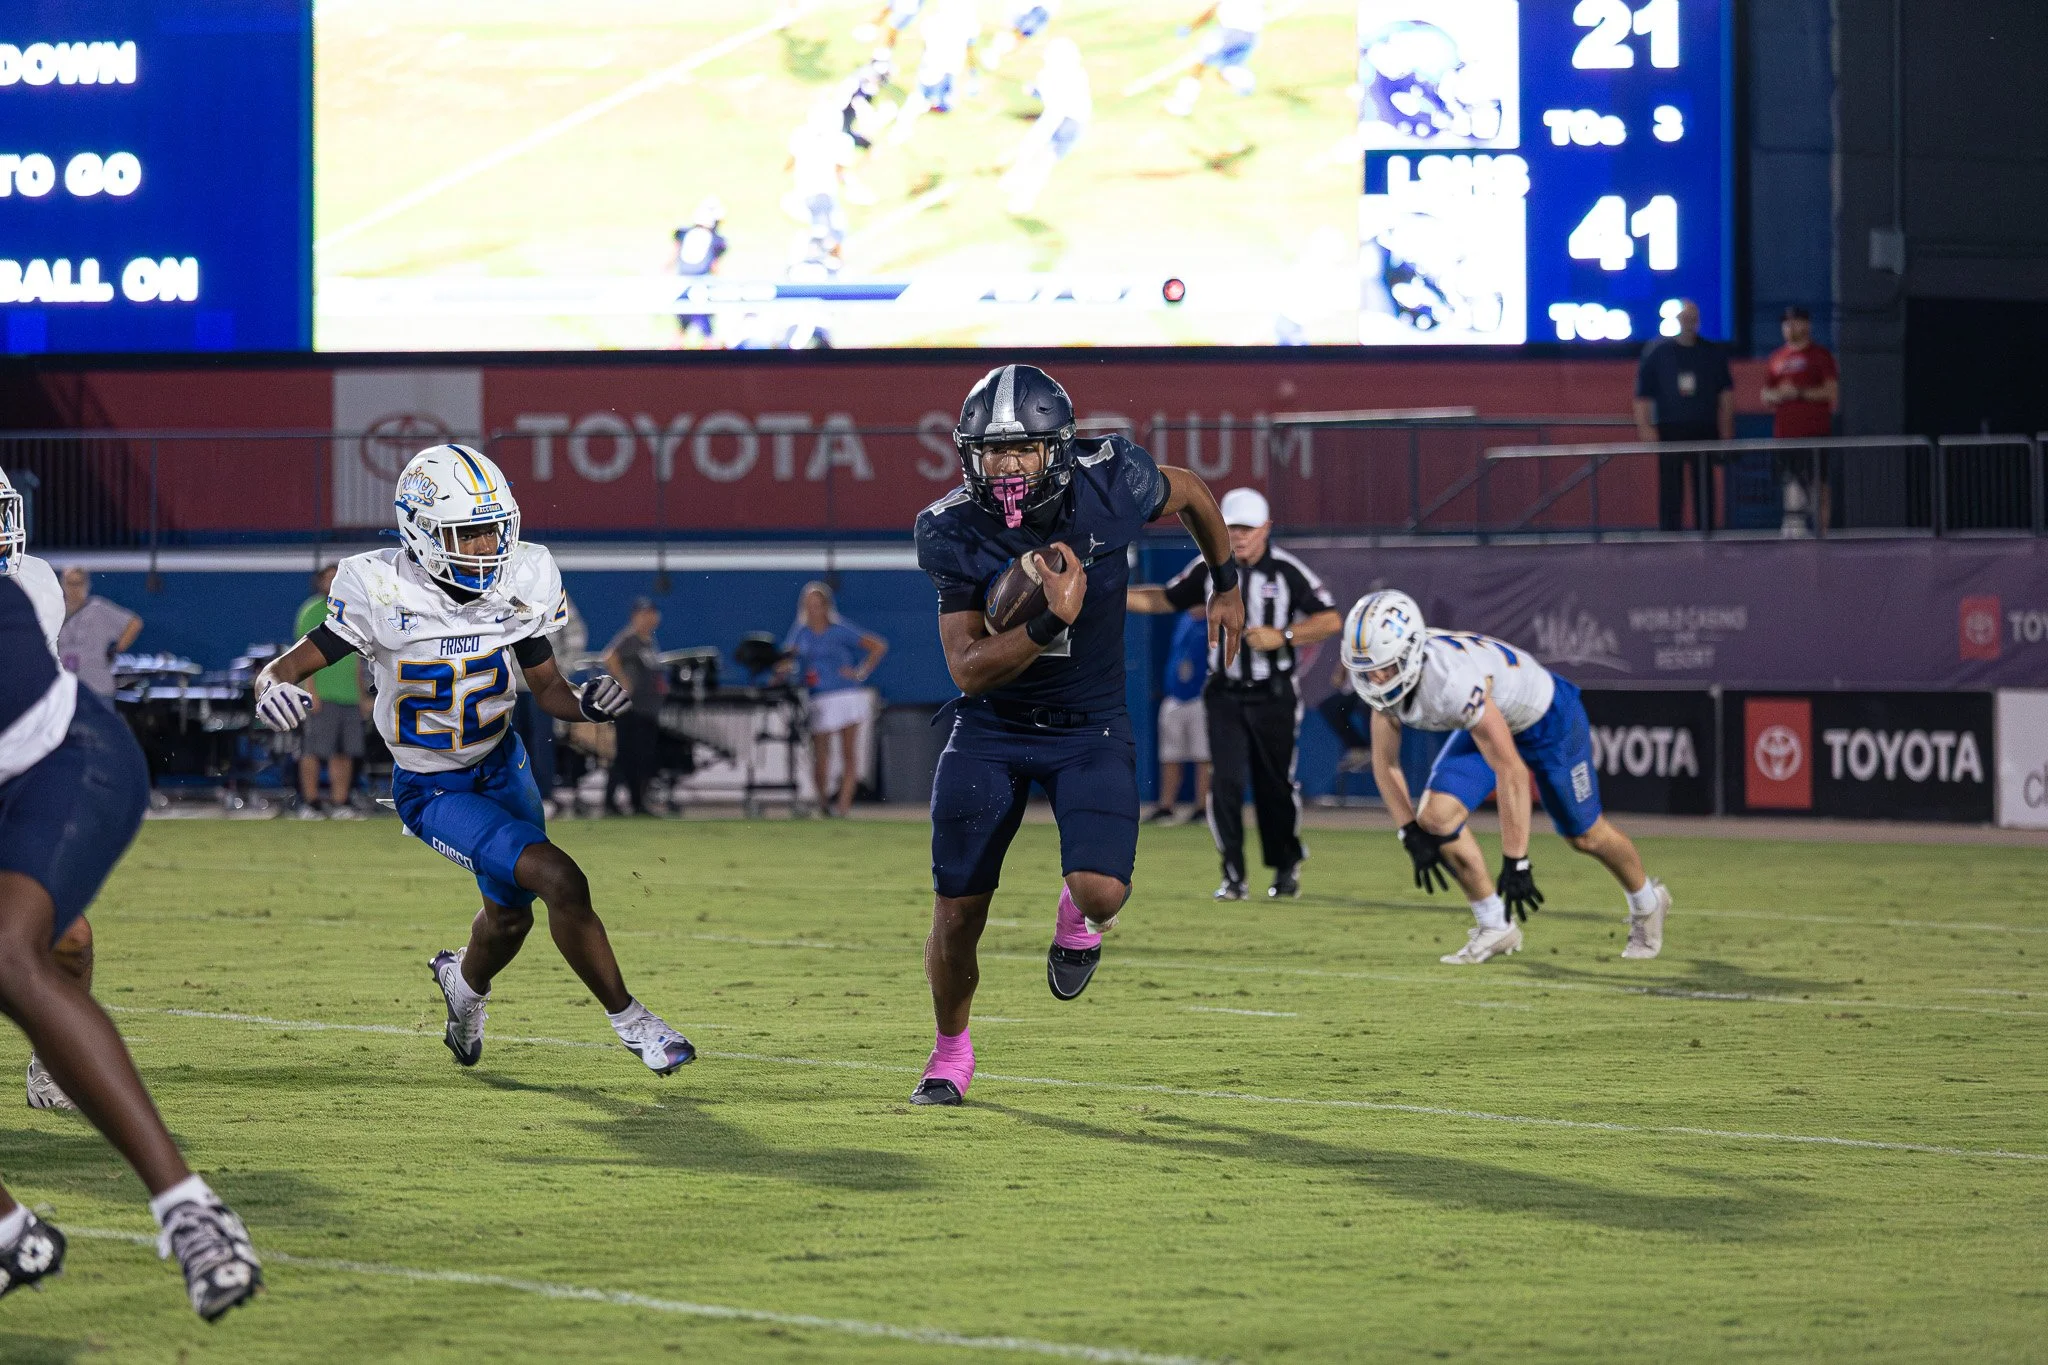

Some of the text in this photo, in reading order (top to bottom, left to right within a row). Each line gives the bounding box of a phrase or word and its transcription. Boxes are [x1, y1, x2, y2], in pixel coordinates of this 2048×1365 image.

[1572, 0, 1679, 69] 21
[0, 41, 137, 86] DOWN
[0, 152, 142, 197] TO GO
[1568, 195, 1678, 271] 41
[0, 256, 199, 303] BALL ON
[516, 411, 1312, 483] TOYOTA SIUM
[440, 635, 480, 656] FRISCO
[396, 647, 510, 753] 22
[1590, 725, 1700, 777] YOTA
[1823, 729, 1985, 784] TOYOTA
